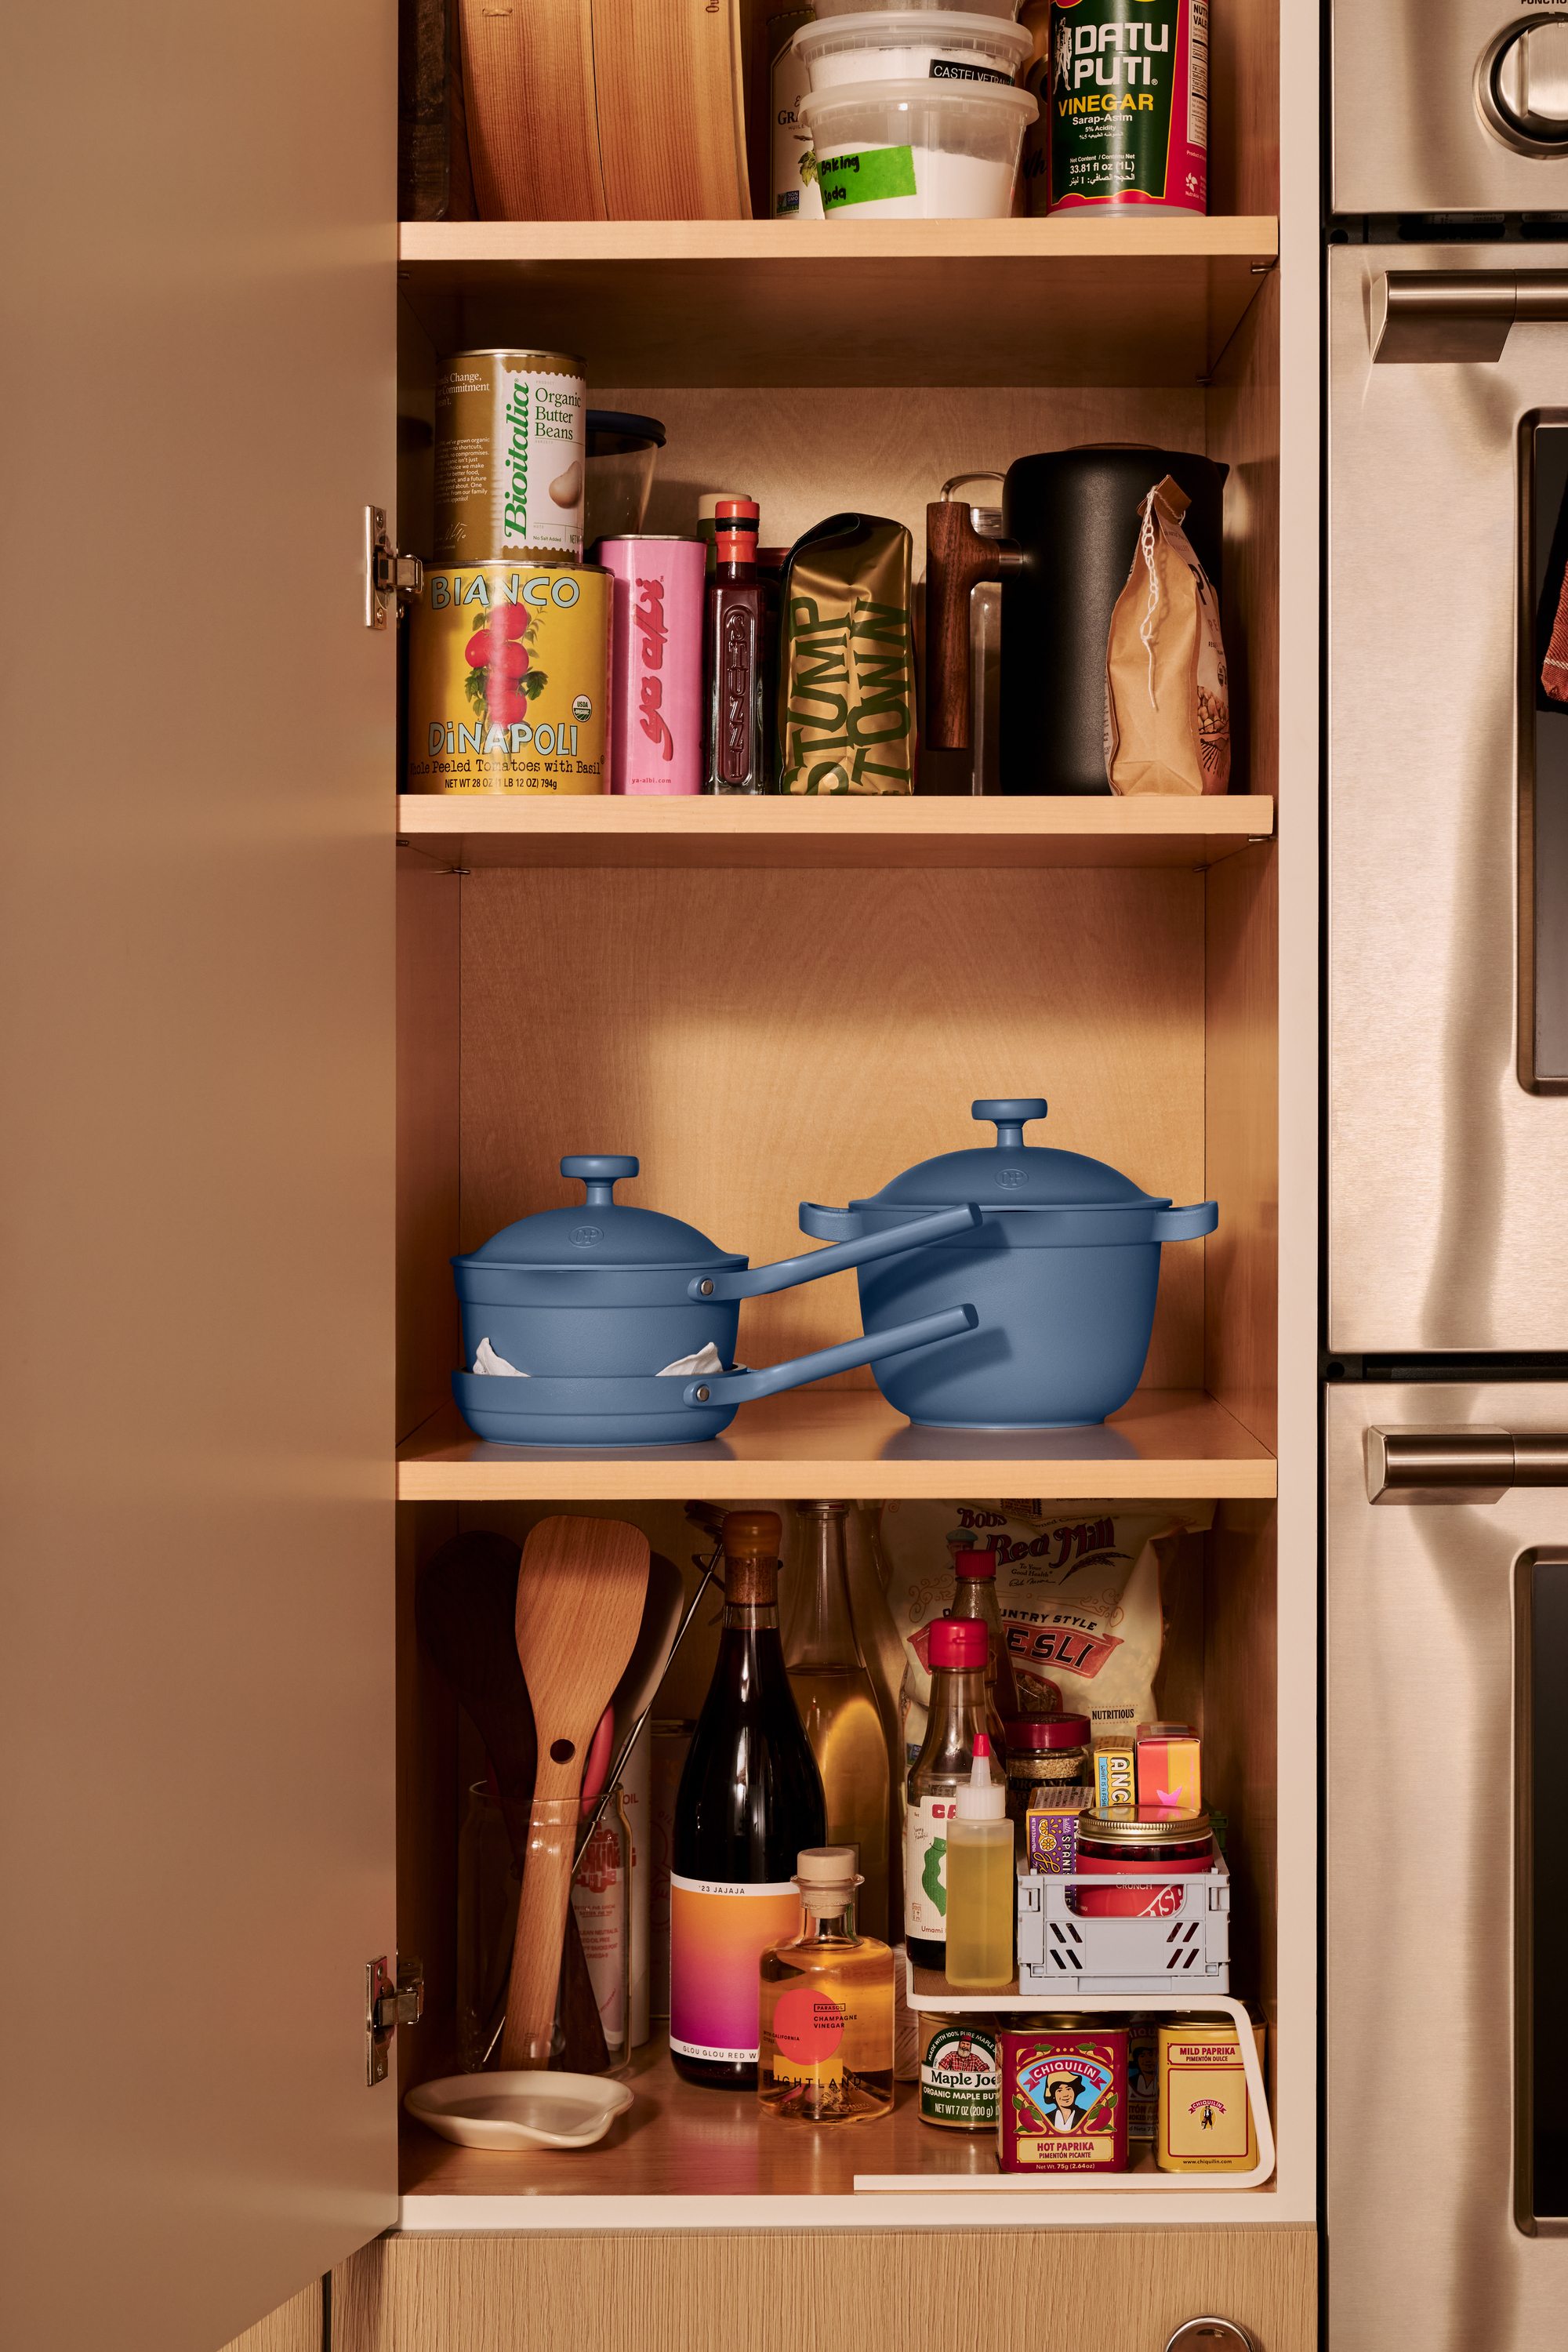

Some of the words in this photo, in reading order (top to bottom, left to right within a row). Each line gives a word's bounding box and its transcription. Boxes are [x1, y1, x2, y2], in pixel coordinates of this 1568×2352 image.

[1074, 22, 1169, 56] DATU
[1074, 56, 1151, 89] PUTI
[1058, 93, 1154, 117] VINEGAR
[1072, 113, 1133, 125] Sarap-Asim
[822, 155, 860, 176] Baking
[1069, 162, 1091, 174] 33.81
[1093, 162, 1099, 171] fl
[1116, 161, 1134, 172] (1L)
[449, 372, 482, 383] Change,
[442, 383, 490, 395] Commitment
[535, 388, 581, 408] Organic
[535, 406, 573, 423] Butter
[535, 422, 573, 440] Beans
[503, 382, 529, 539] Bioitalia
[431, 574, 580, 609] BIANCO
[726, 614, 749, 779] STUZZI
[783, 597, 855, 795] STUMP
[846, 597, 912, 786] TOWN
[428, 721, 579, 757] DiNAPOLI
[432, 759, 472, 773] Peeled
[476, 758, 541, 772] Tomatoes
[544, 759, 573, 772] with
[576, 760, 601, 775] Basil
[445, 779, 458, 789] NET
[459, 779, 471, 788] WT
[472, 778, 481, 788] 28
[482, 778, 493, 787] OZ
[504, 778, 514, 787] LB
[516, 778, 524, 787] 12
[526, 778, 539, 789] OZ)
[541, 779, 557, 790] 794g
[985, 1533, 1051, 1566] Red
[1048, 1516, 1116, 1569] Mill
[1052, 1615, 1098, 1631] STYLE
[1006, 1627, 1095, 1668] ESLI
[1092, 1708, 1134, 1720] NUTRITIOUS
[622, 1794, 639, 1806] OIL
[772, 2032, 800, 2041] CALIFORNIA
[683, 2045, 699, 2055] GLOU
[702, 2049, 724, 2058] GLOU
[928, 2043, 937, 2060] MADE
[935, 2034, 946, 2045] WITH
[975, 2035, 994, 2049] MAPLE
[1180, 2047, 1200, 2056] MILD
[1033, 2061, 1097, 2078] CHIQUILÍN
[763, 2071, 862, 2089] BRIGHTLAND
[931, 2070, 972, 2089] Maple
[923, 2086, 951, 2099] ORGANIC
[953, 2092, 981, 2100] MAPLE
[935, 2103, 945, 2114] NET
[946, 2104, 955, 2115] WT
[956, 2105, 960, 2114] 7
[961, 2106, 968, 2115] OZ
[970, 2106, 985, 2117] (200
[986, 2105, 993, 2118] g)
[1037, 2143, 1054, 2151] HOT
[1056, 2142, 1094, 2151] PAPRIKA
[1039, 2151, 1068, 2159] PIMENTÓN
